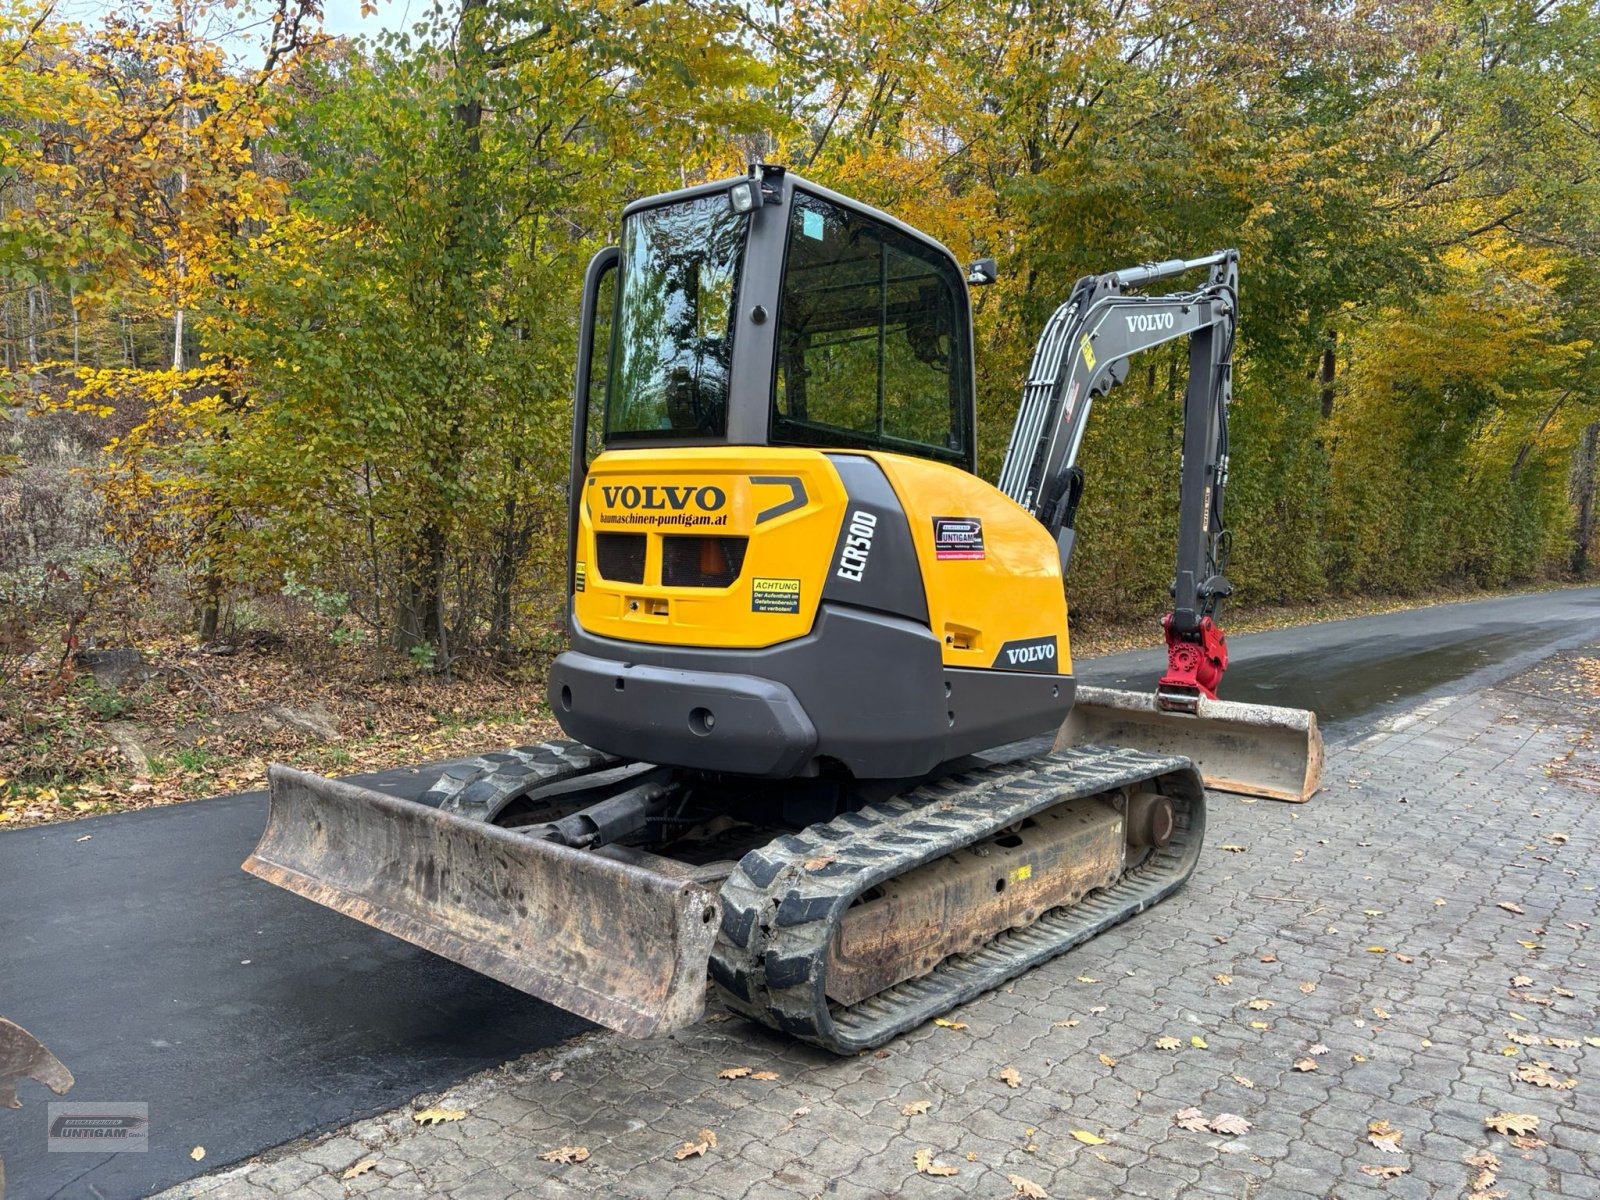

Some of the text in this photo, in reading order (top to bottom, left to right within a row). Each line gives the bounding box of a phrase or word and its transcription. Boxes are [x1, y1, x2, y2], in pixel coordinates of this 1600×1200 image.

[1125, 312, 1174, 333] VOLVO
[602, 485, 726, 512] VOLVO
[600, 512, 728, 528] baumaschinen-puntigam.at
[836, 510, 878, 582] ECR50D
[755, 582, 798, 590] ACHTUNG
[754, 598, 798, 606] Gefahrenbereich
[1006, 643, 1055, 665] VOLVO
